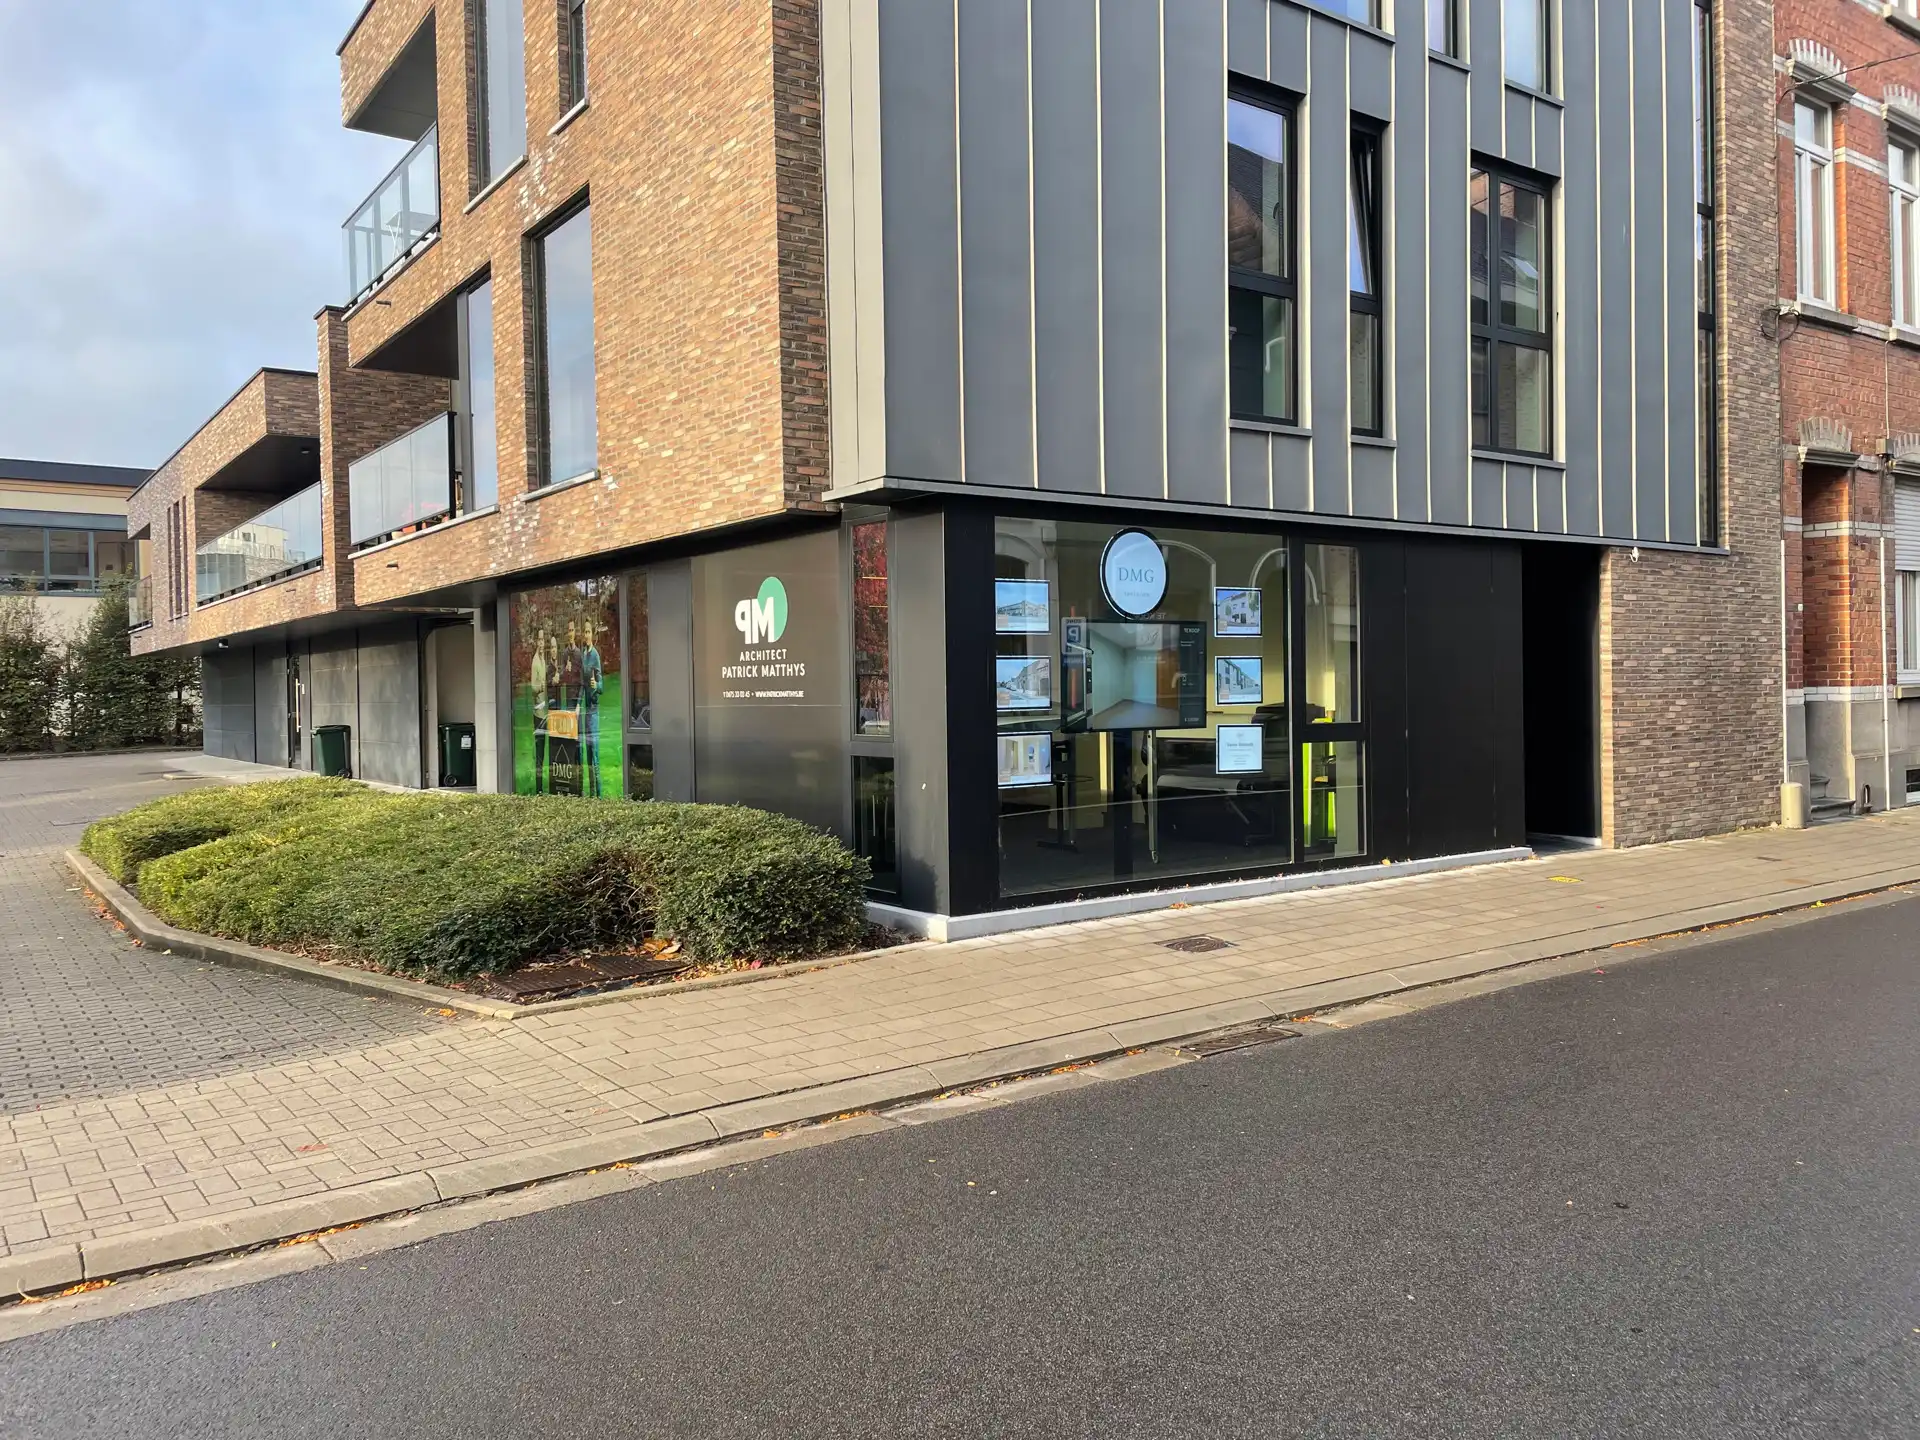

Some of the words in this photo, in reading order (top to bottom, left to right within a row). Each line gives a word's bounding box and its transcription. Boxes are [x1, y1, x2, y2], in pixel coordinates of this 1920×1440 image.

[1118, 567, 1154, 583] DMG
[739, 648, 787, 662] ARCHITECT
[722, 665, 758, 679] PATRICK
[761, 662, 806, 678] MATTHYS
[552, 762, 572, 779] DMG
